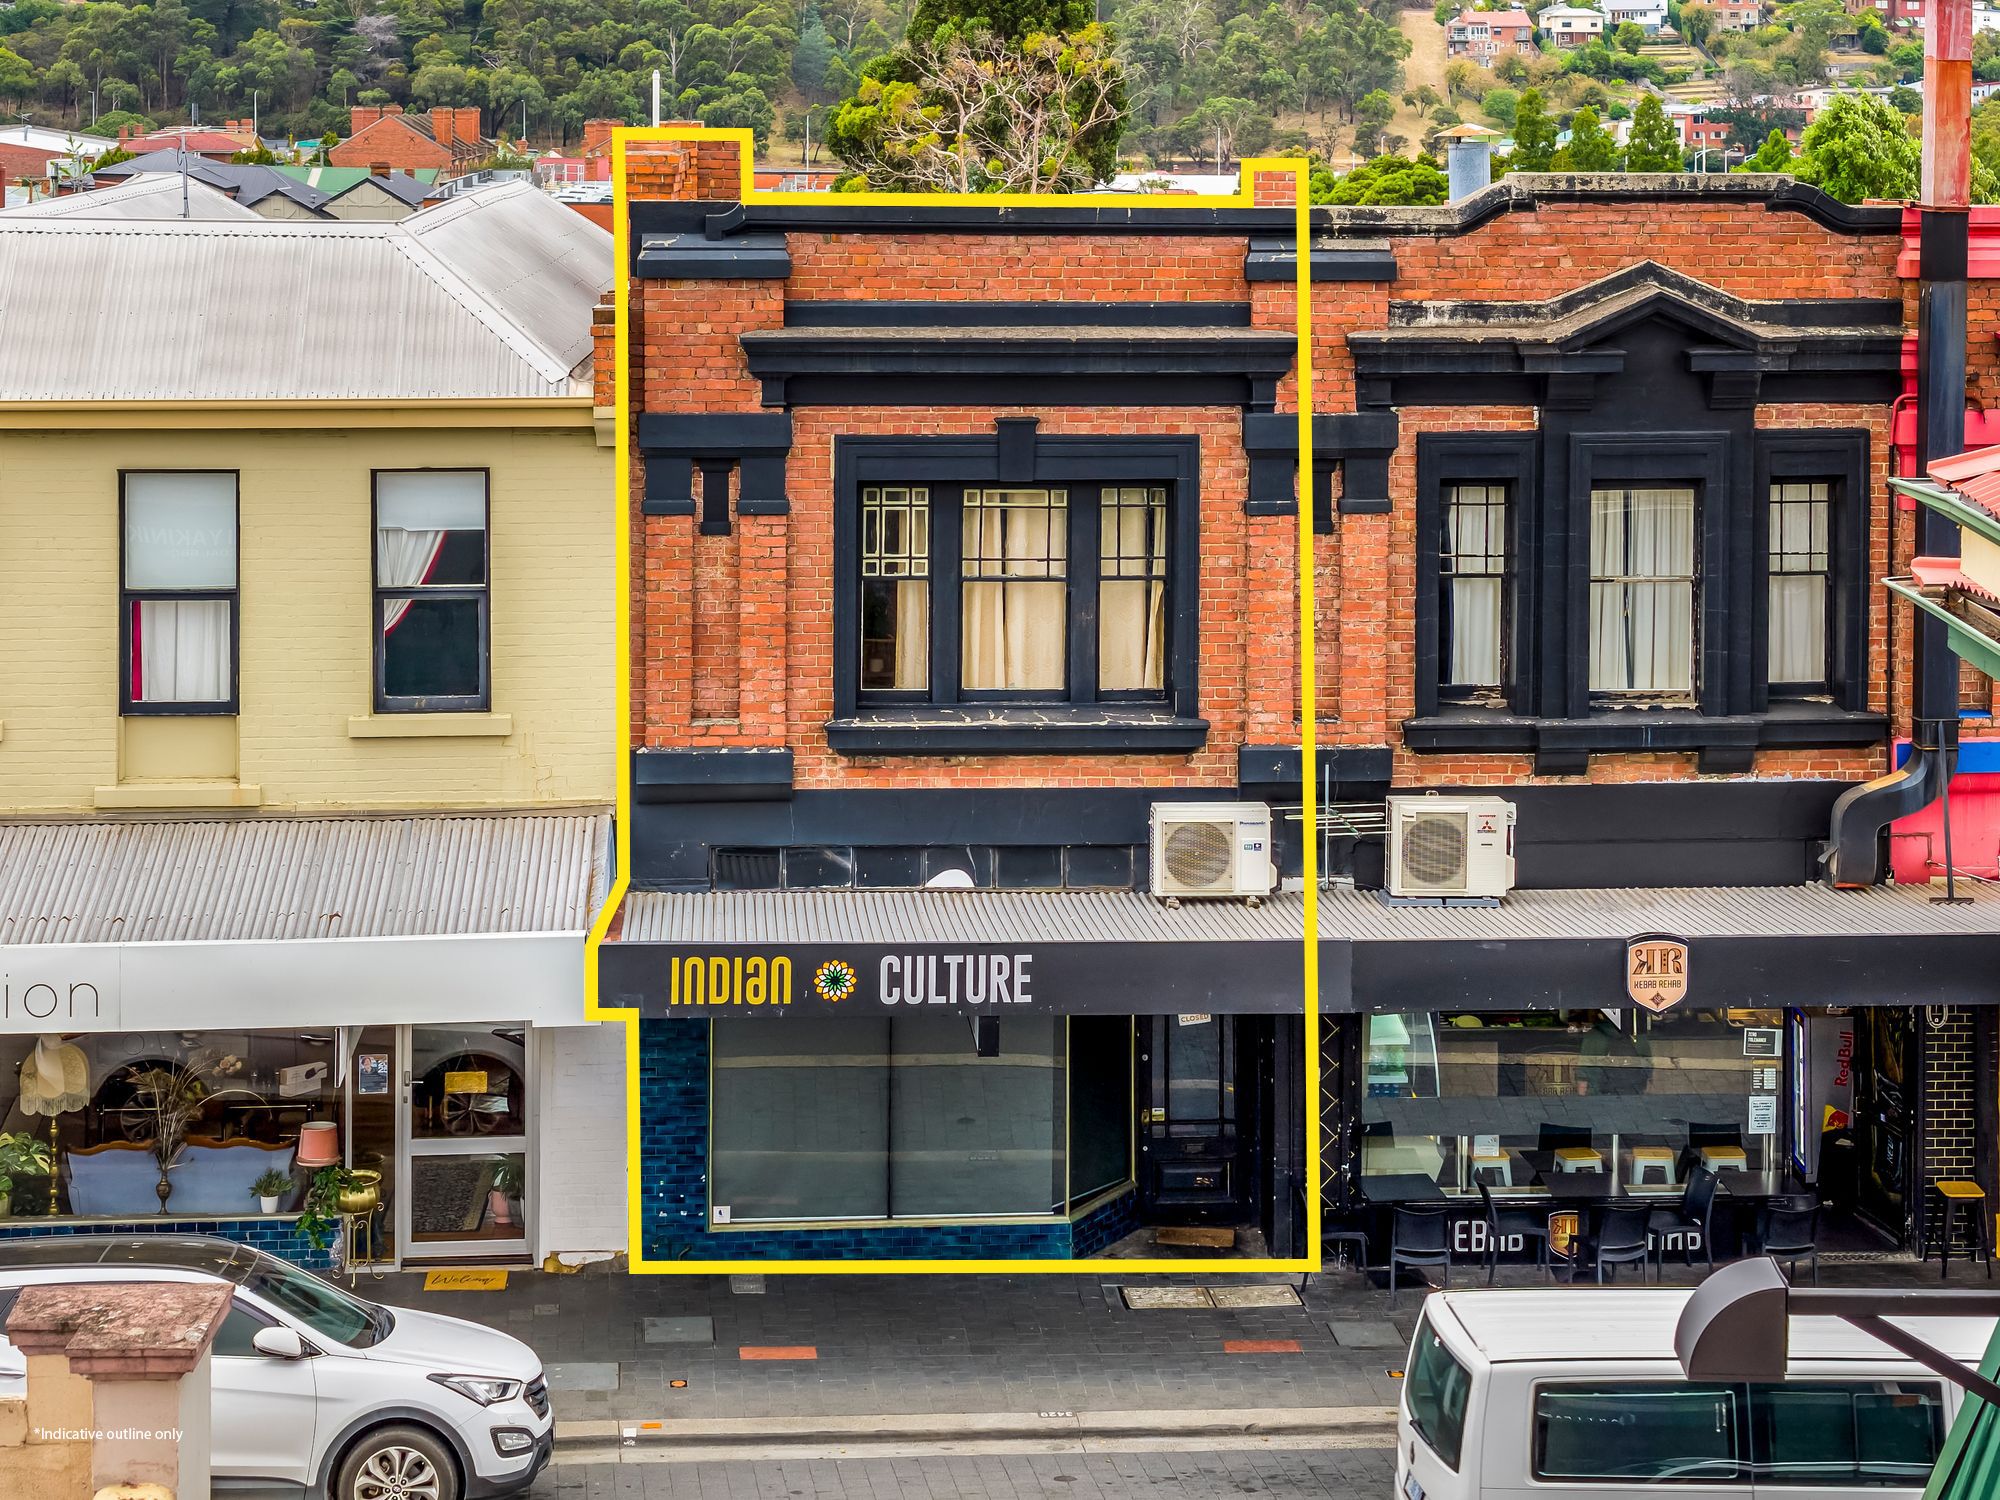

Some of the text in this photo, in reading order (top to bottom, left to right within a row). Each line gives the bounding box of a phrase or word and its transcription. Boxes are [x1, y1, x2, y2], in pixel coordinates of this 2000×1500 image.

[879, 954, 1033, 1005] CULTURE
[1634, 979, 1682, 989] KEBAB REHAB
[5, 973, 99, 1019] ion
[1180, 1013, 1209, 1023] CLOSED
